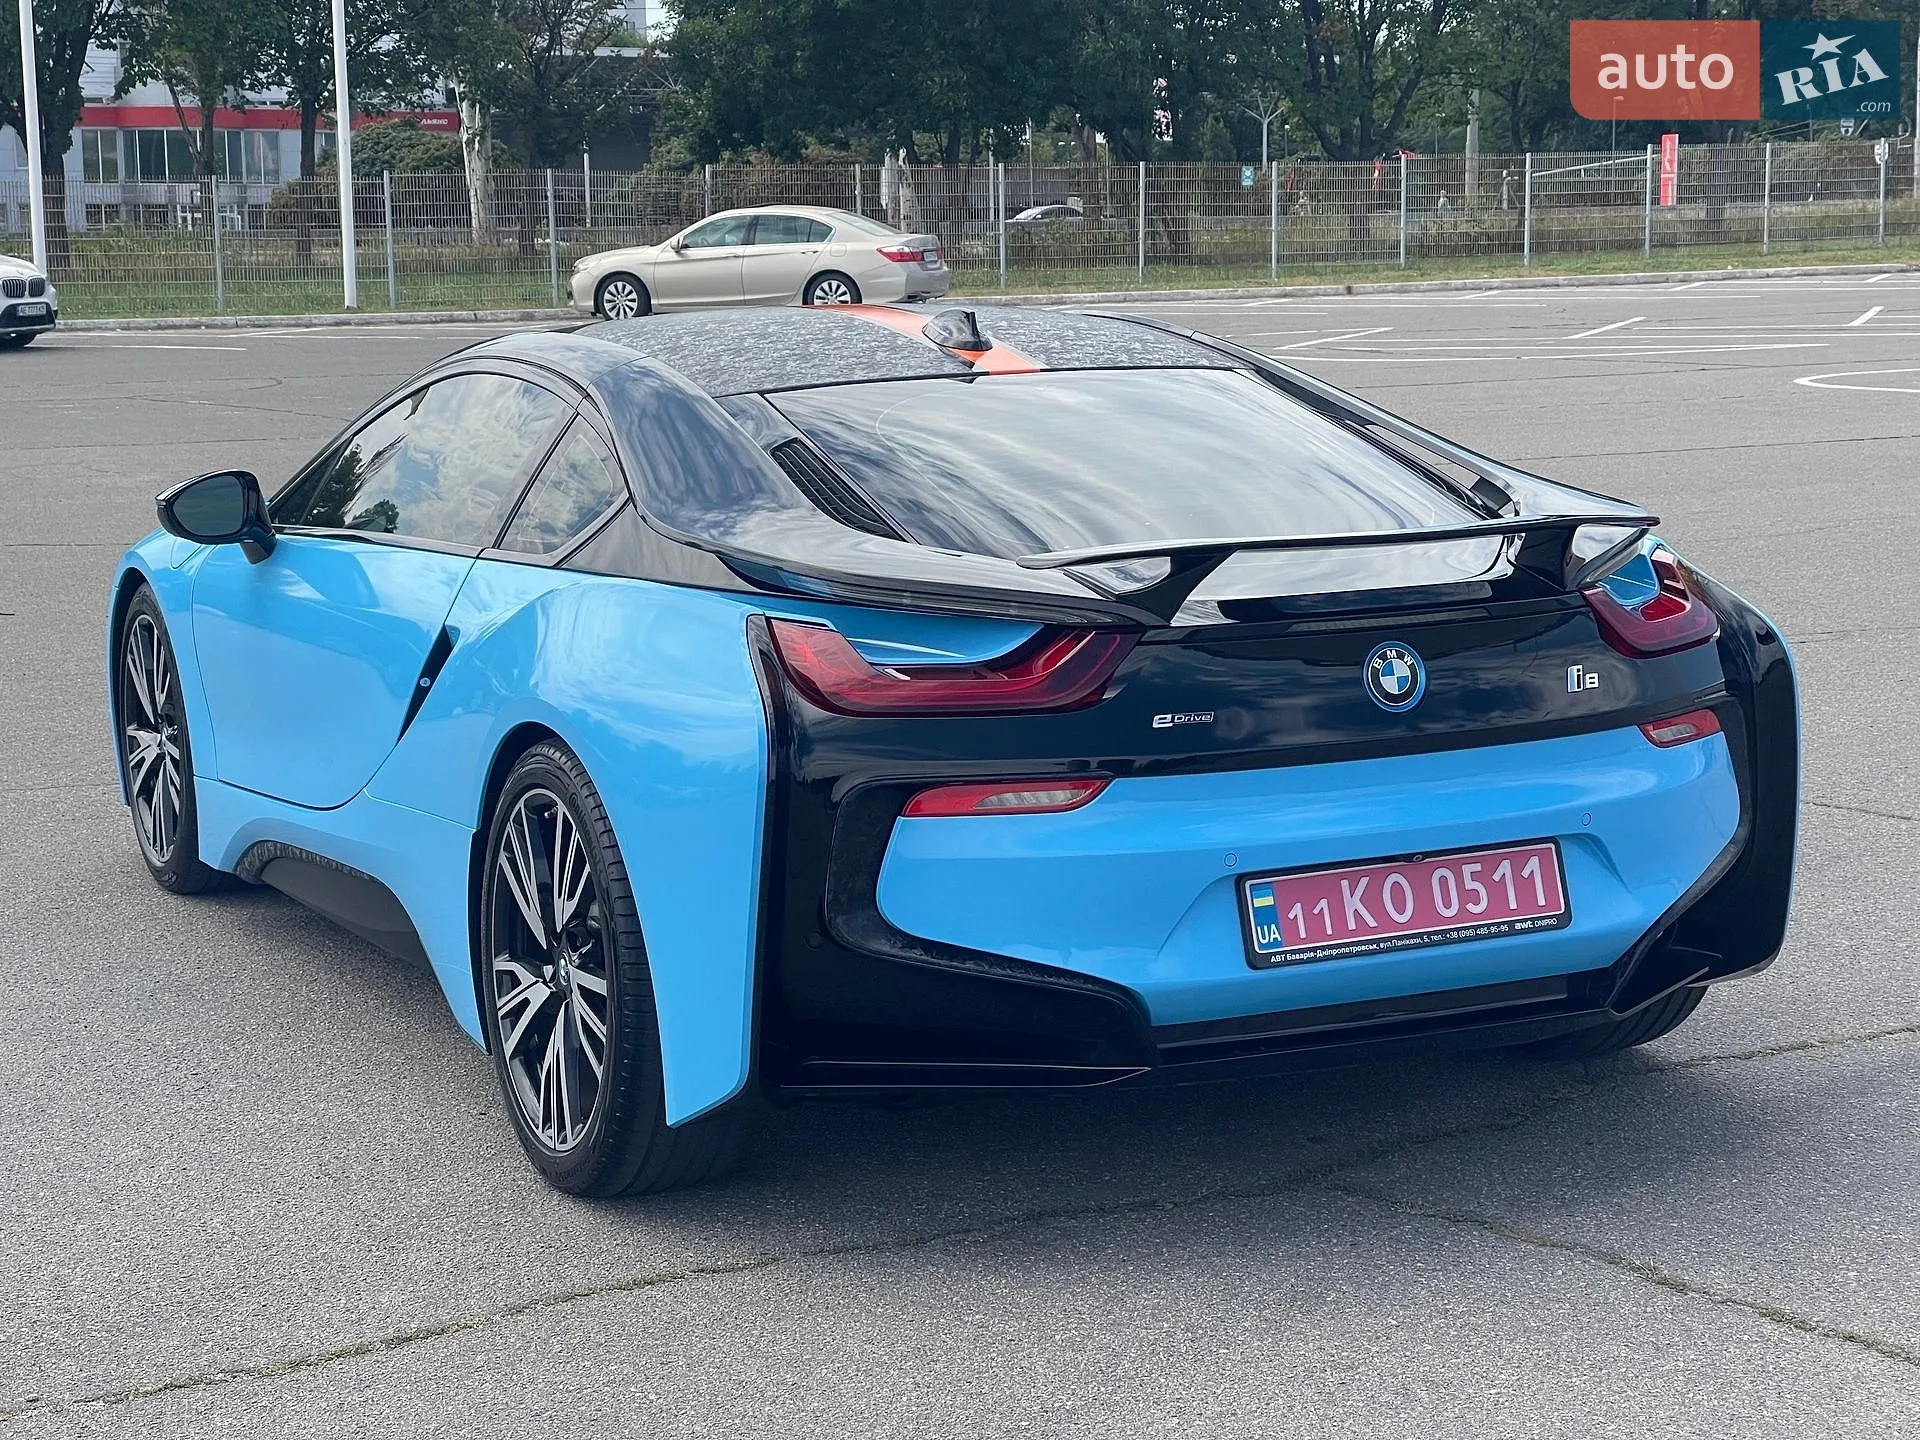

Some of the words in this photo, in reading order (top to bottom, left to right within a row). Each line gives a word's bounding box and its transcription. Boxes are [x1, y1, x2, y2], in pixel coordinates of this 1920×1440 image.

[1373, 649, 1413, 670] BMW
[1431, 855, 1546, 918] 0511
[1458, 927, 1476, 938] (095)
[1476, 924, 1509, 935] 485-95-95
[1534, 917, 1558, 928] DNIPRO
[1257, 923, 1282, 944] UA
